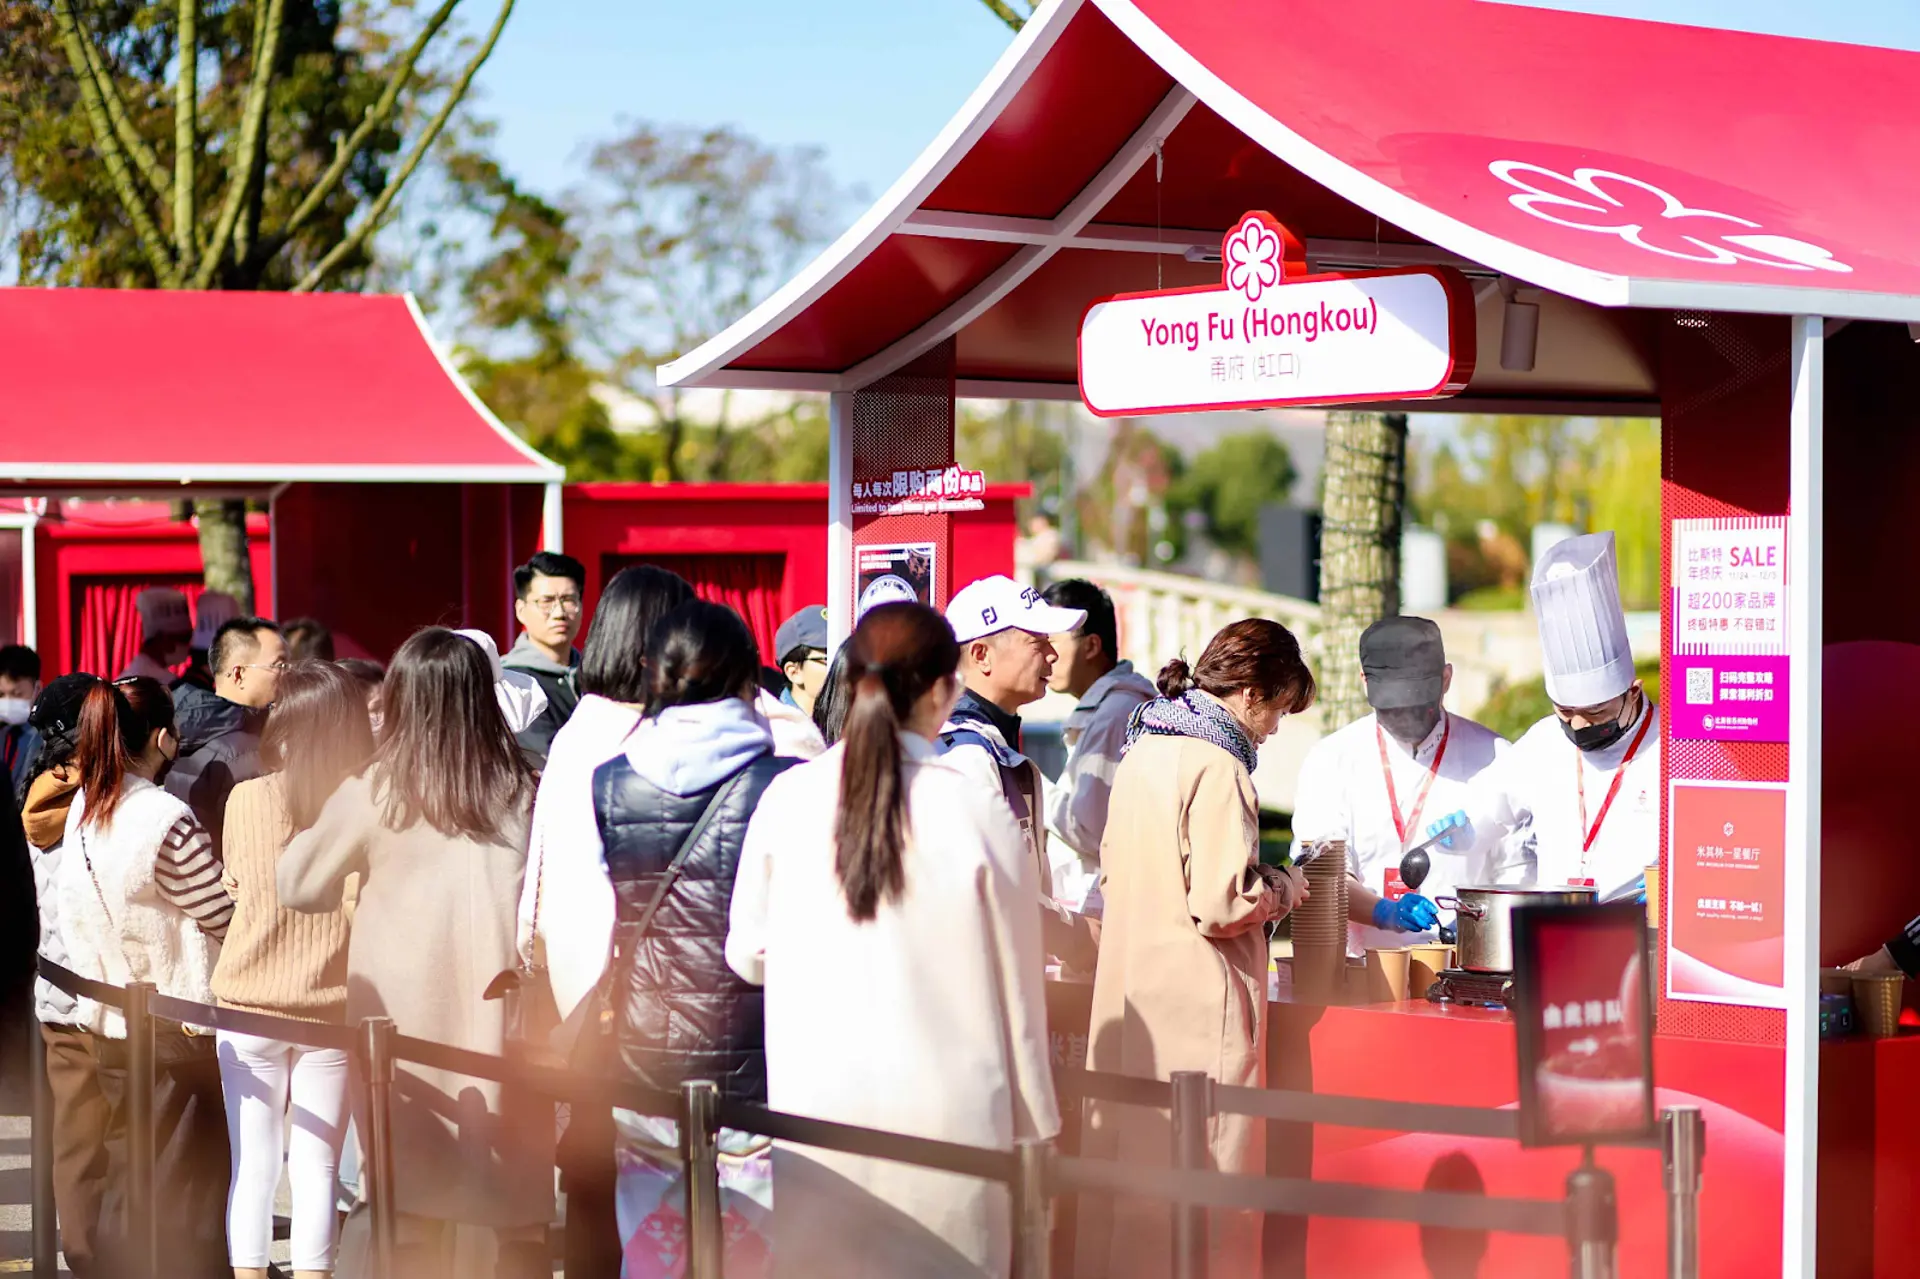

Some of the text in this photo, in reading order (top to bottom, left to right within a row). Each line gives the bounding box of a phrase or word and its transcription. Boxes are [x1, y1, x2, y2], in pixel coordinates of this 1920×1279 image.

[1141, 297, 1378, 351] Yong Fu (Hongkou)
[1210, 351, 1300, 382] 甬府 (虹口)
[853, 466, 981, 498] 每人每次限购两份单品
[851, 503, 878, 513] Limited
[1688, 547, 1723, 562] 比斯特
[1730, 546, 1776, 567] SALE
[1688, 565, 1723, 580] 年终庆
[1687, 591, 1777, 610] 超200家品牌
[981, 606, 998, 626] FJ
[1687, 618, 1776, 631] 终极特惠 不容错过
[1696, 845, 1761, 861] 米其林一星餐厅
